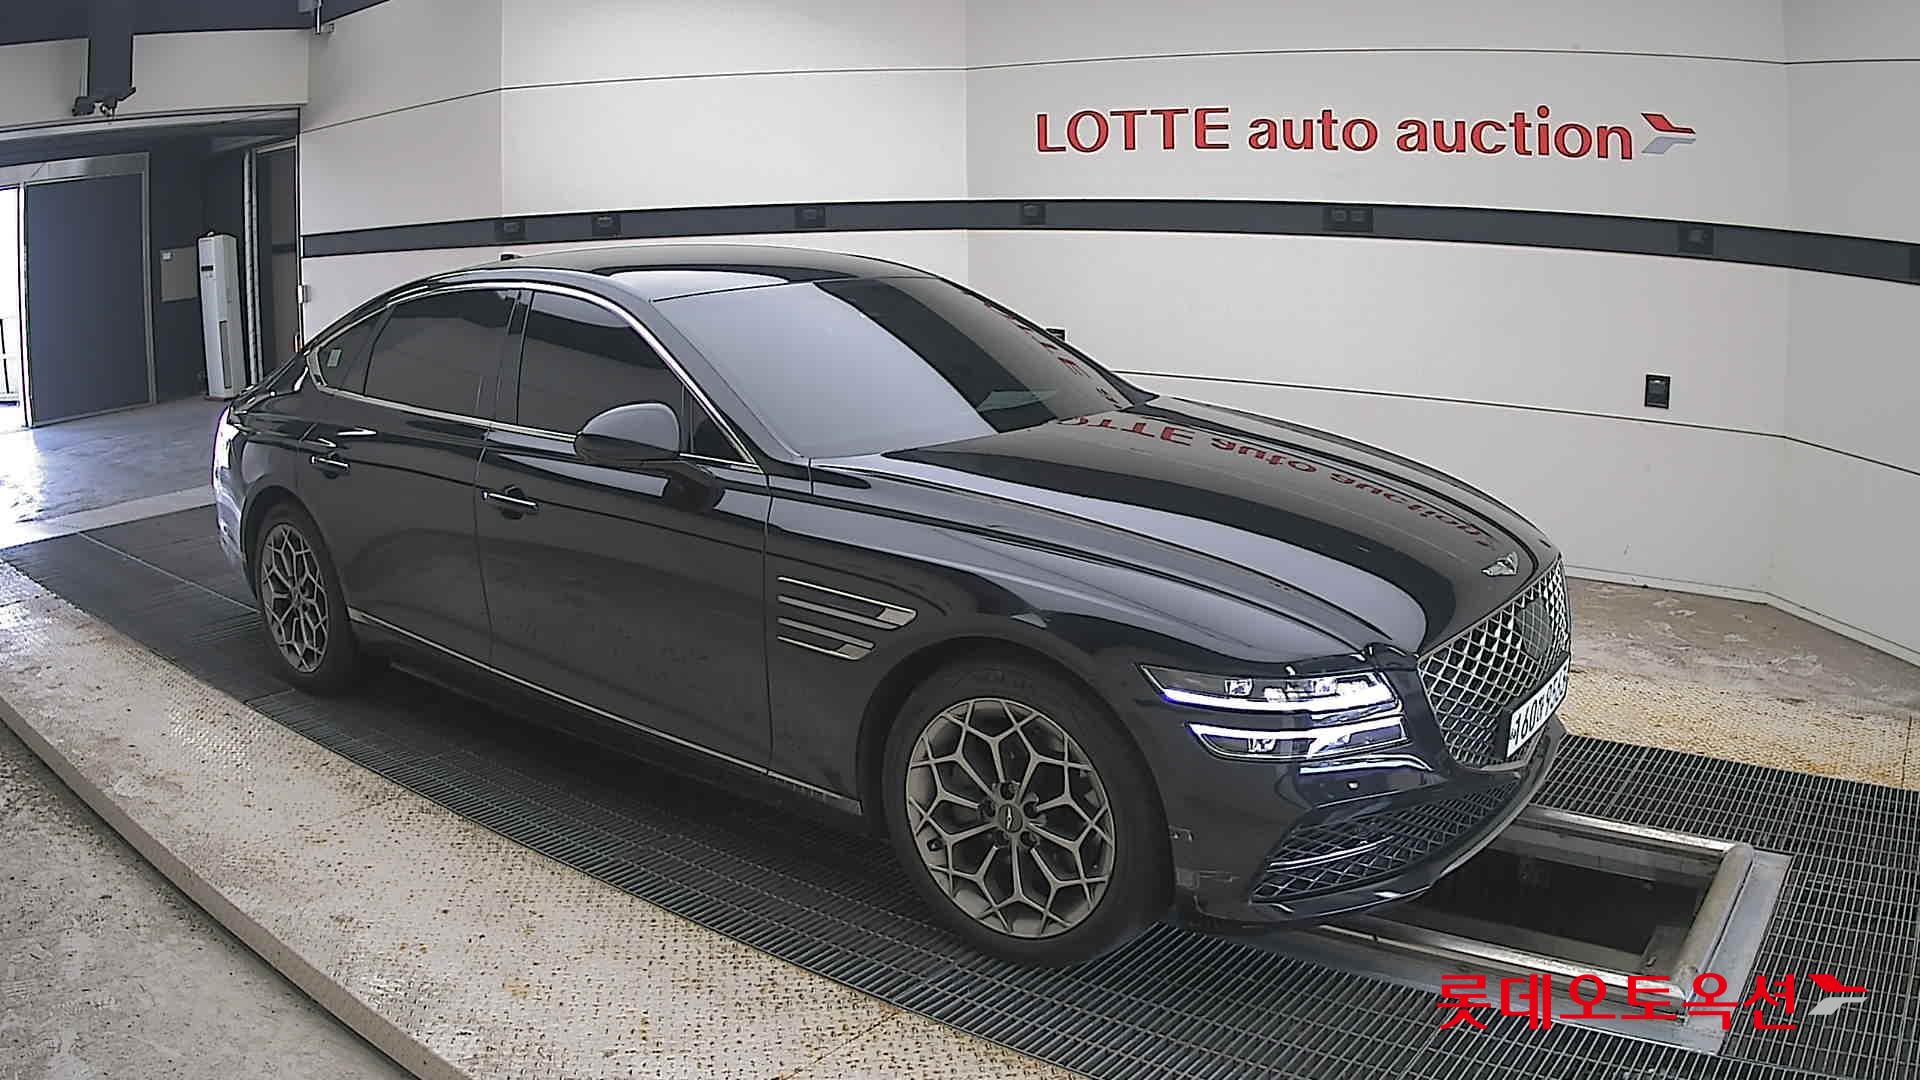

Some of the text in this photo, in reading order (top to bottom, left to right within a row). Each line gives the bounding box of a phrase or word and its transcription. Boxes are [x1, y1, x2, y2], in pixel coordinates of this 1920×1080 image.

[1037, 105, 1635, 161] LOTTE auto auction
